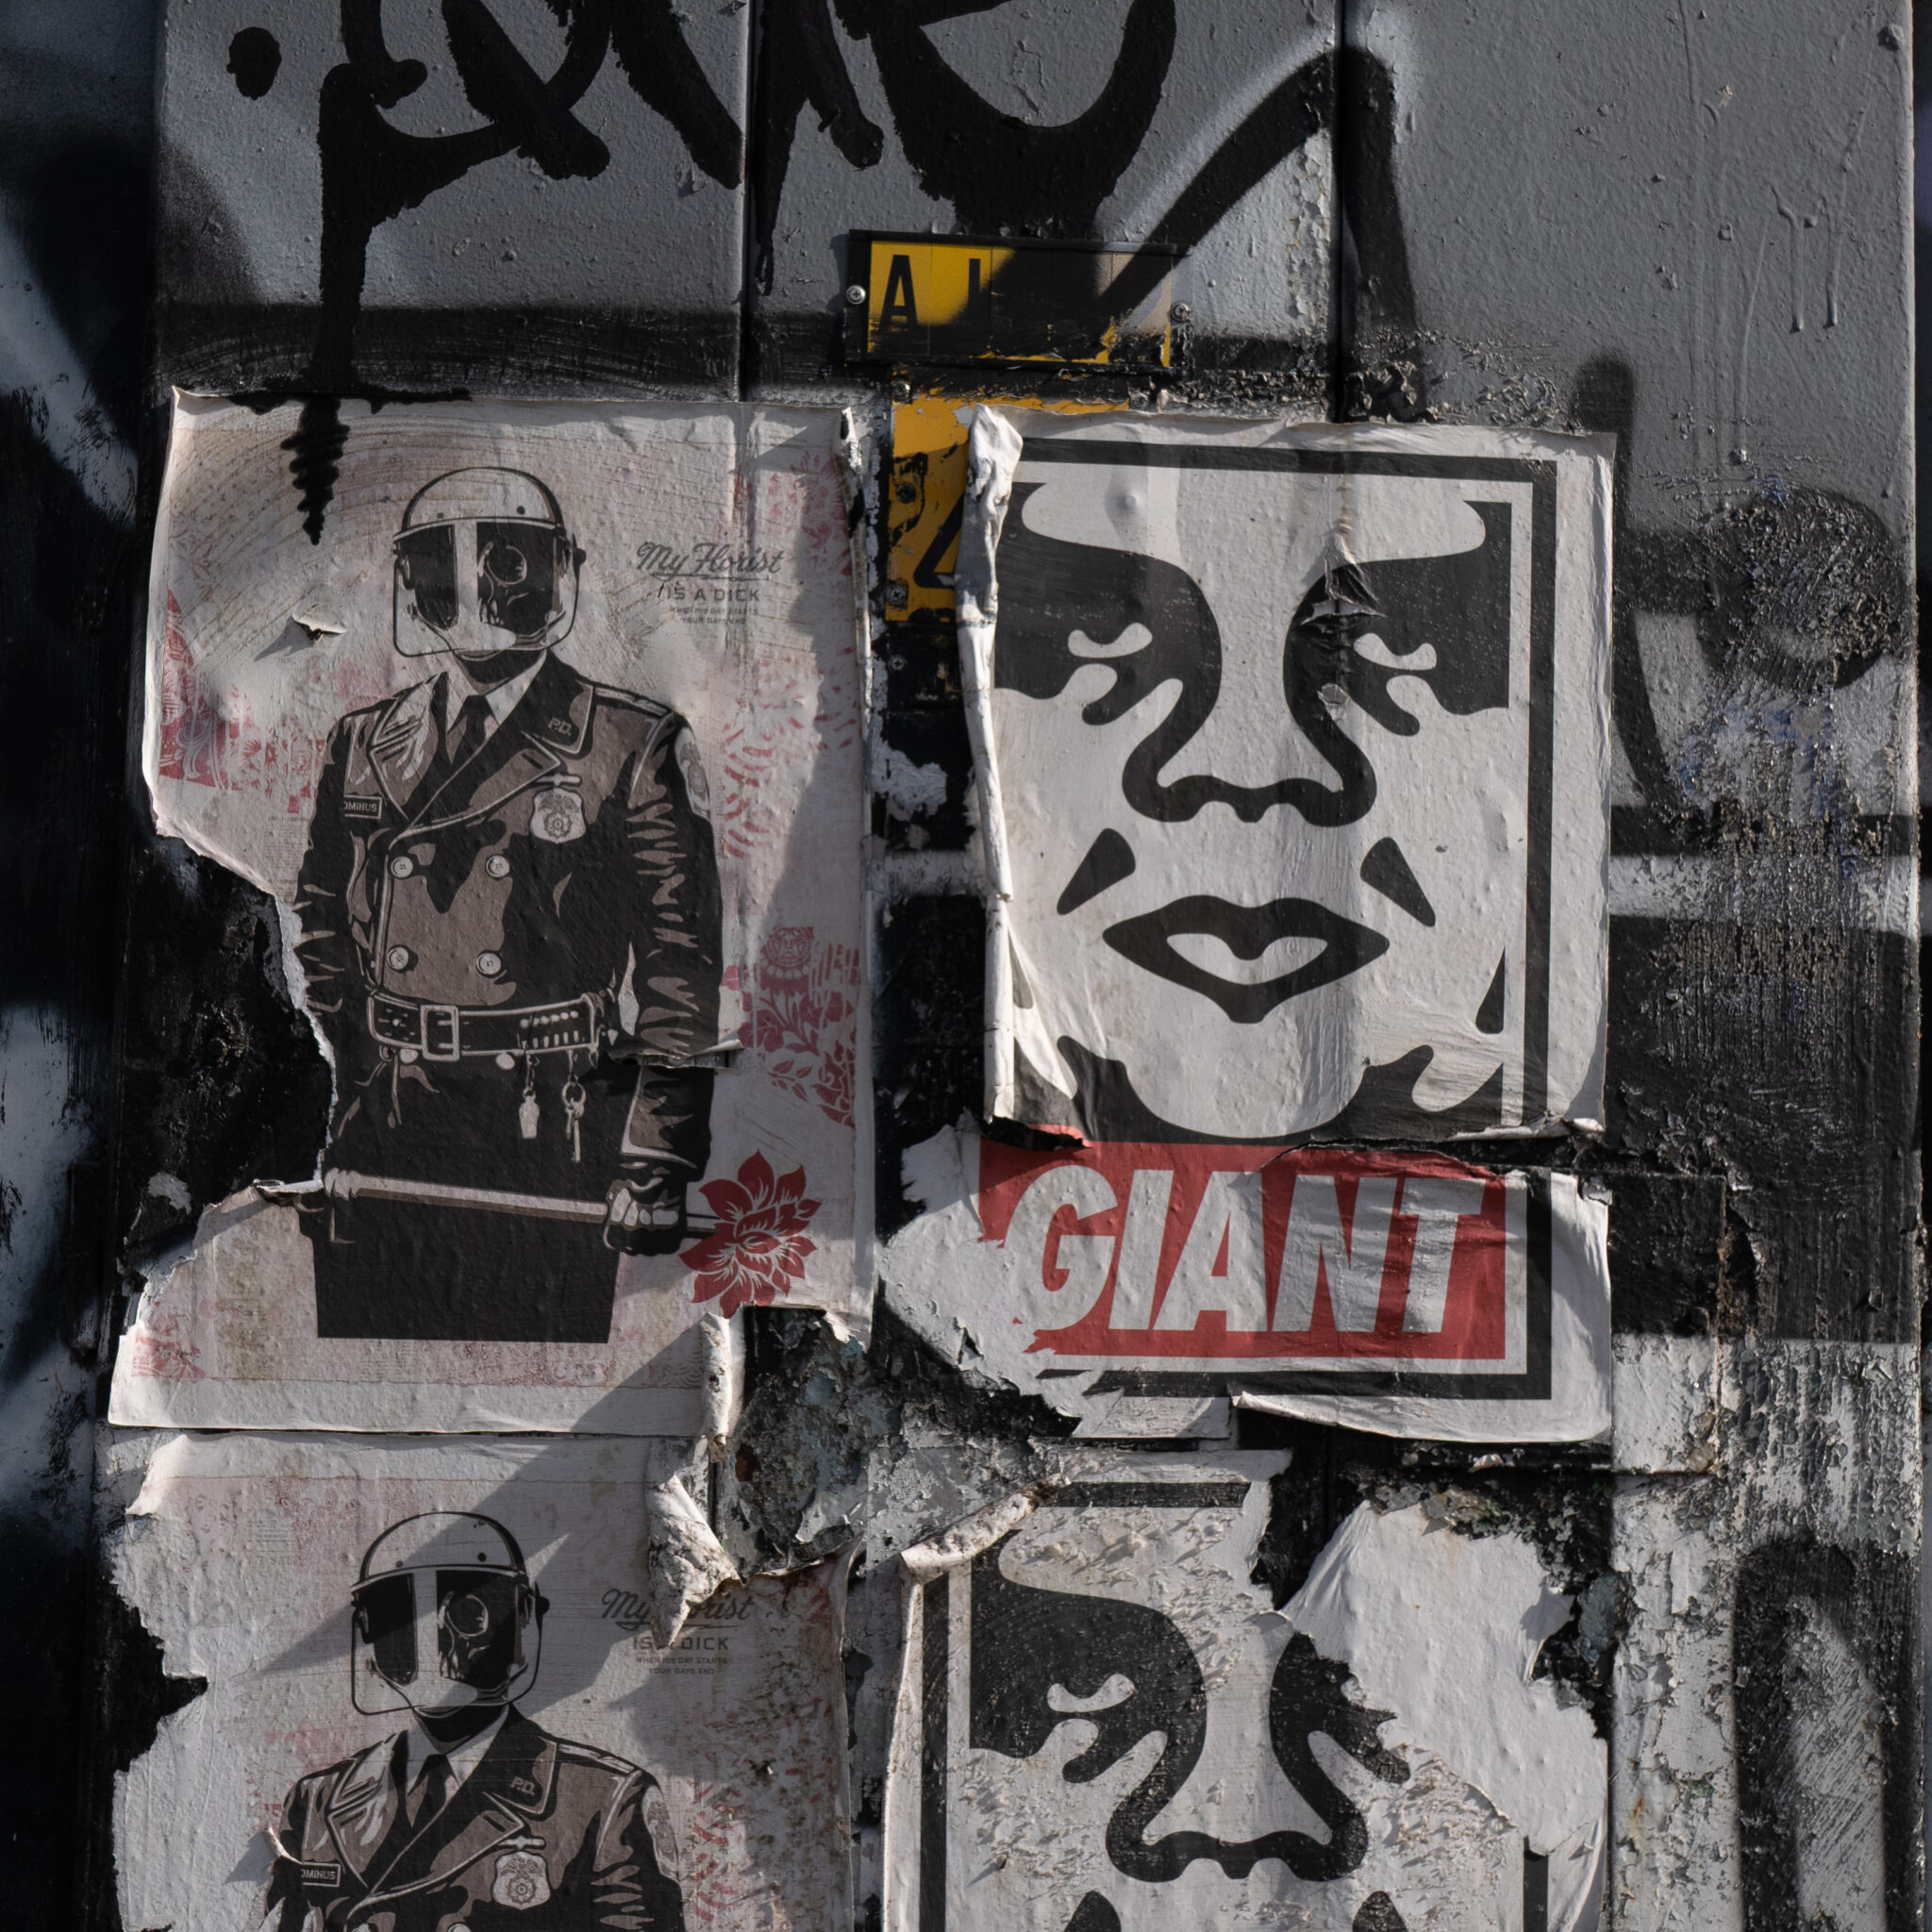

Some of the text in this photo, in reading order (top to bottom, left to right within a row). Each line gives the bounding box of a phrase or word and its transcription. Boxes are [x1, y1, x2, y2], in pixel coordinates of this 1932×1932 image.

[637, 541, 785, 582] My Florist
[666, 586, 760, 602] IS A DICK
[1004, 1164, 1487, 1334] GIANT
[601, 1588, 755, 1631] My orist
[633, 1636, 729, 1650] IS DICK
